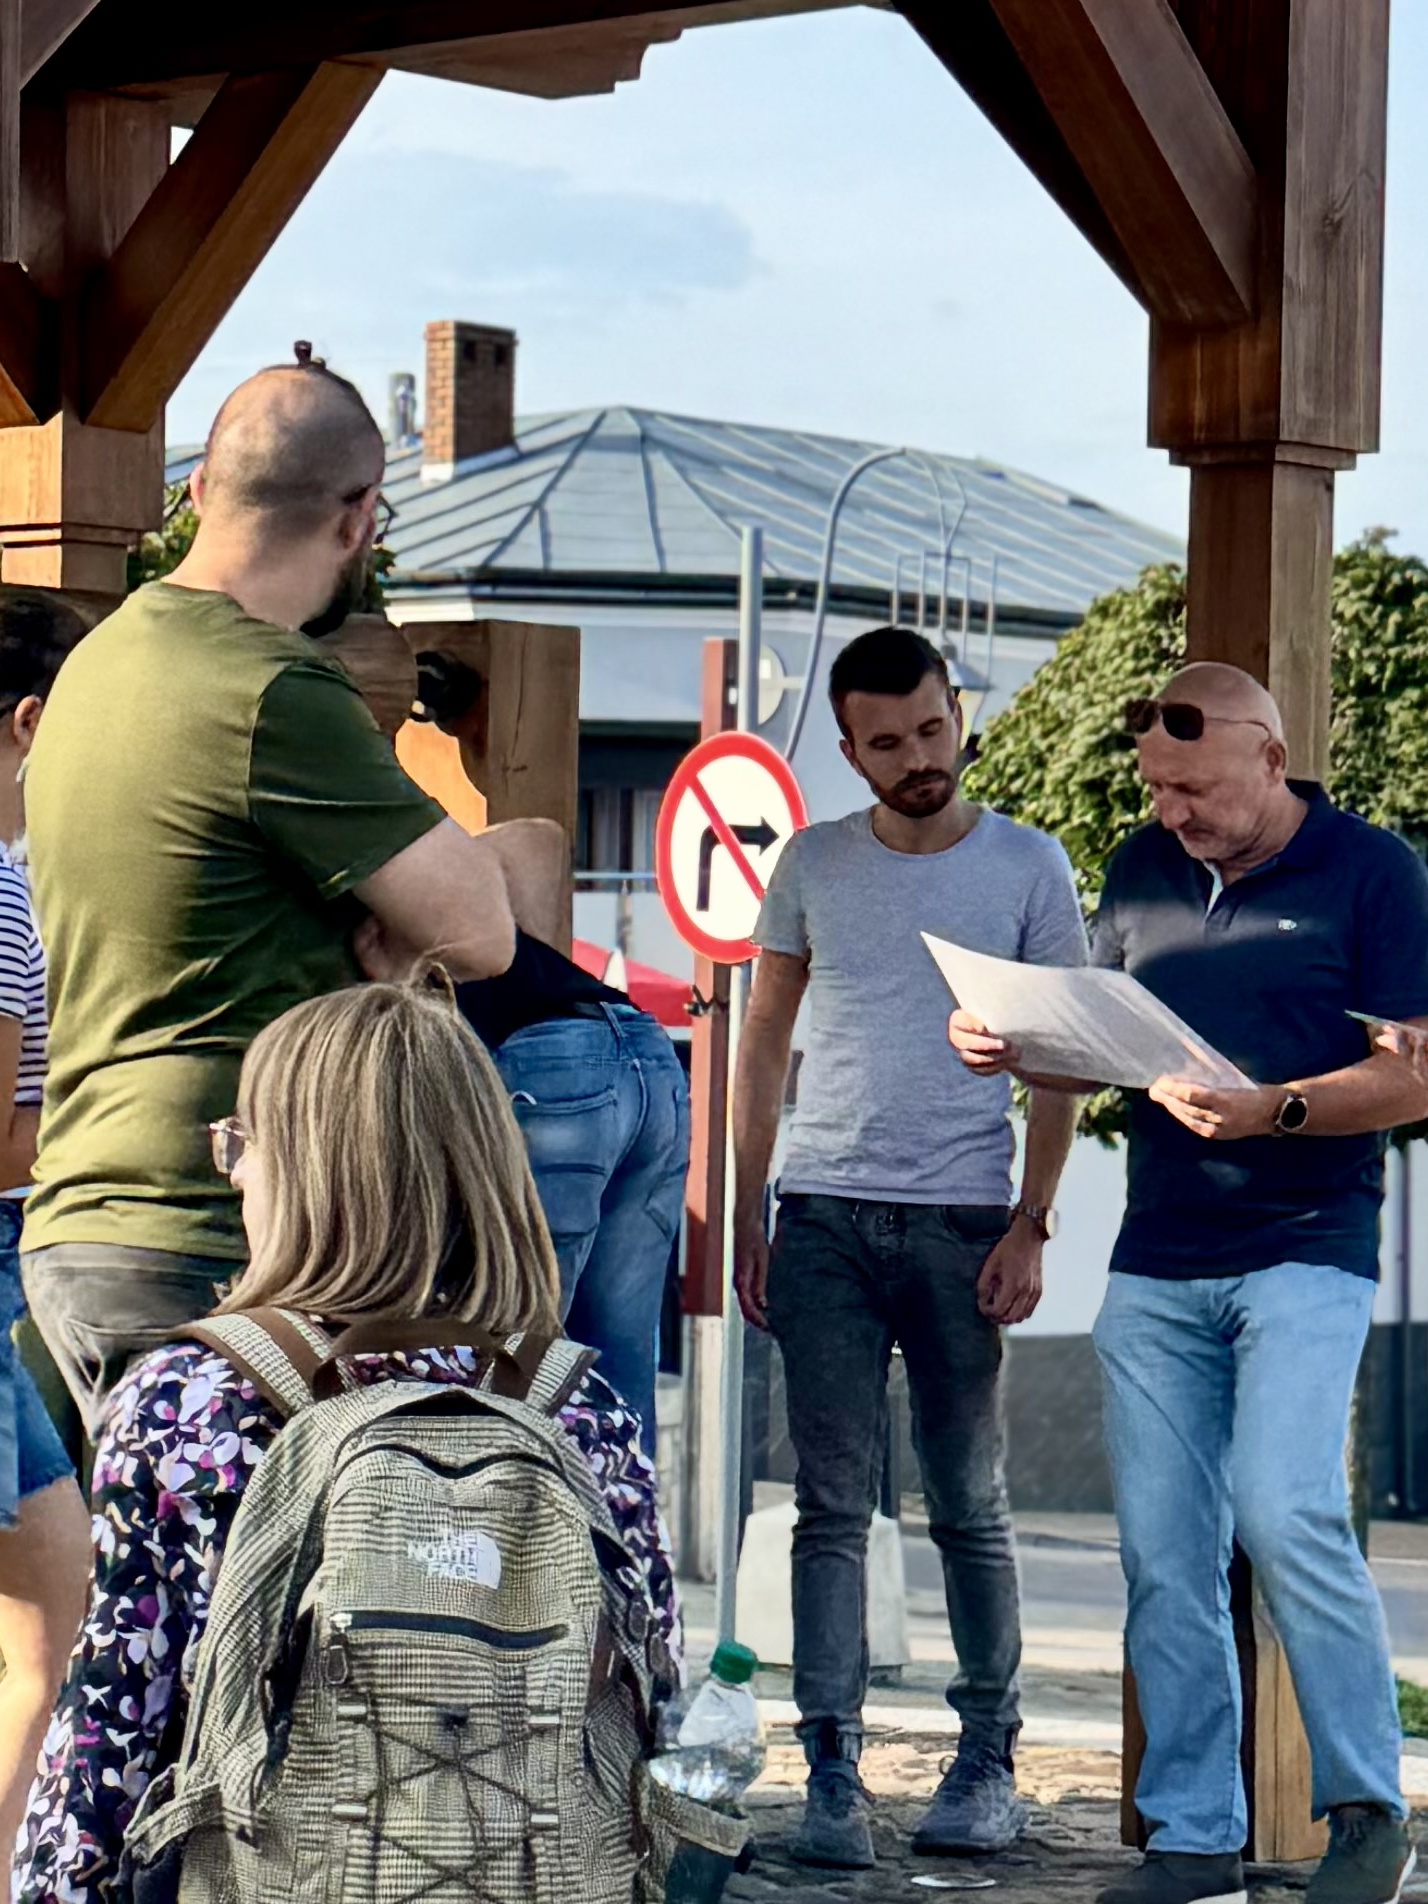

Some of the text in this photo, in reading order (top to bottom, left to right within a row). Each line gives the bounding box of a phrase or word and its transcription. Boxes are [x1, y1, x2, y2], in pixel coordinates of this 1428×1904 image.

[442, 1529, 477, 1546] THE
[407, 1541, 477, 1564] NORTH
[427, 1561, 477, 1581] FACE
